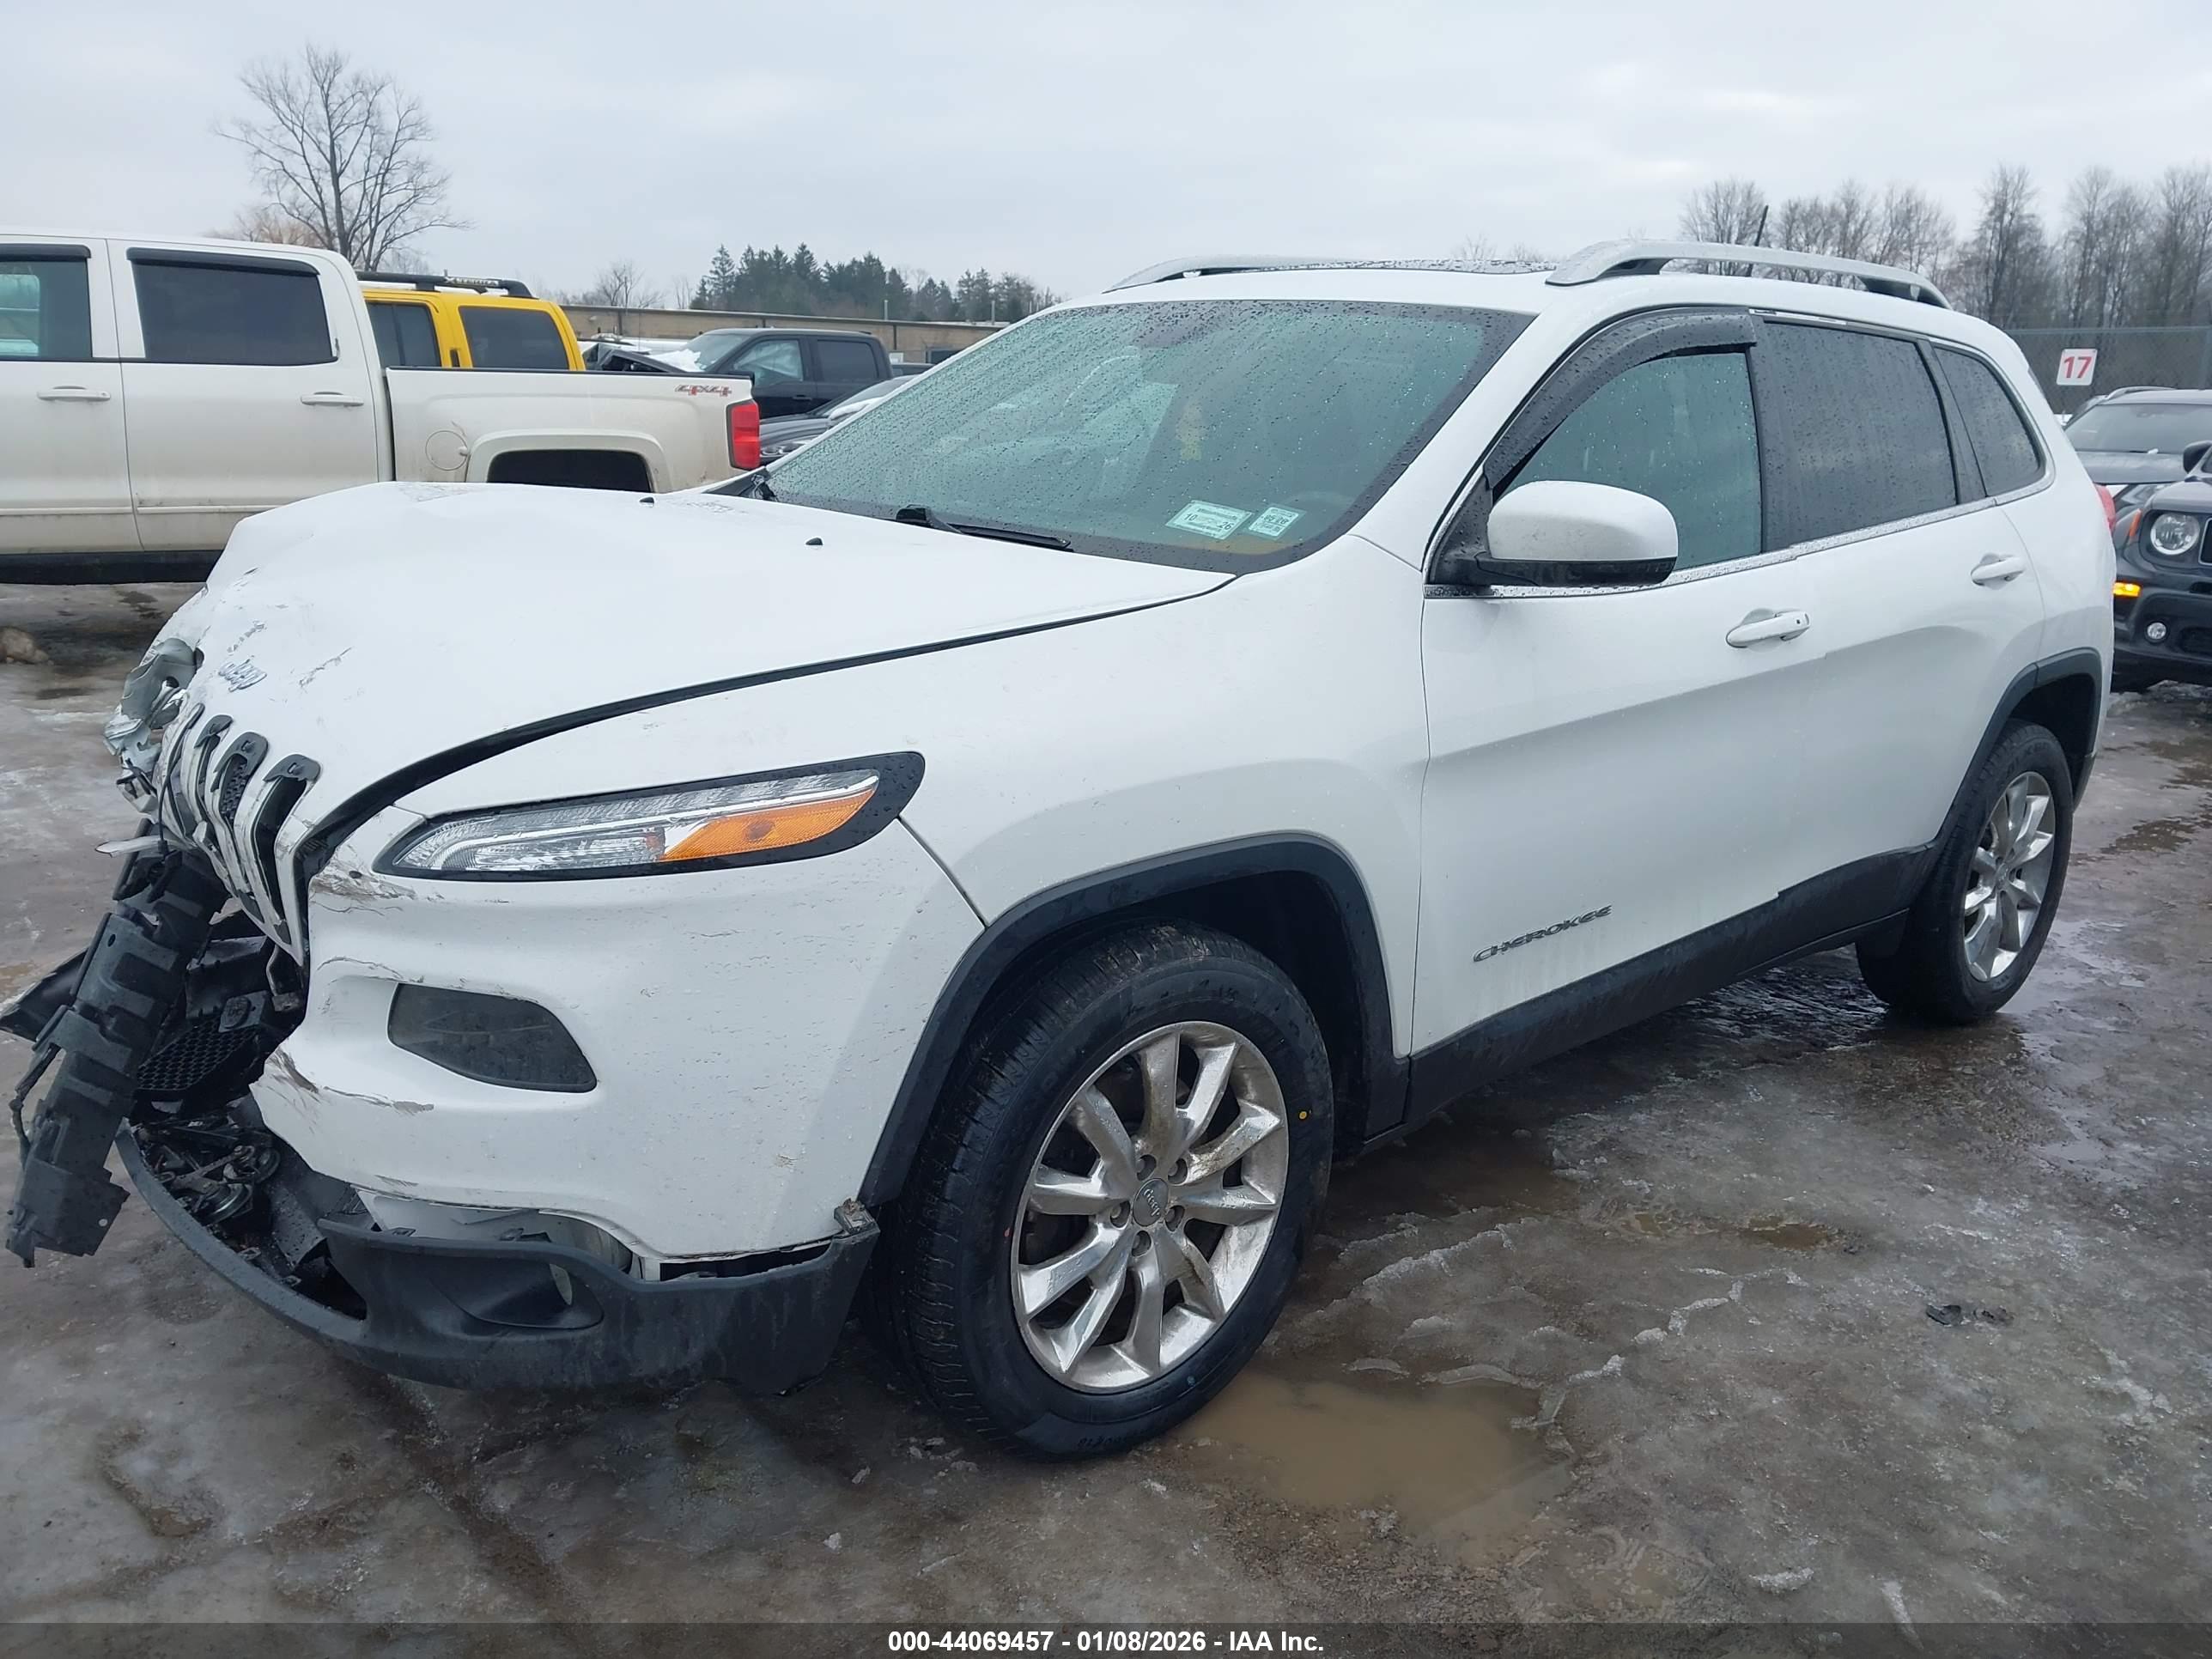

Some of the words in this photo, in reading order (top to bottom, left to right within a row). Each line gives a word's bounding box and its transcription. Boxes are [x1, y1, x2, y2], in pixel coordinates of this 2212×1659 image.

[2063, 356, 2093, 379] 17
[1217, 521, 1234, 530] 26
[1473, 904, 1613, 962] CHEROKEE
